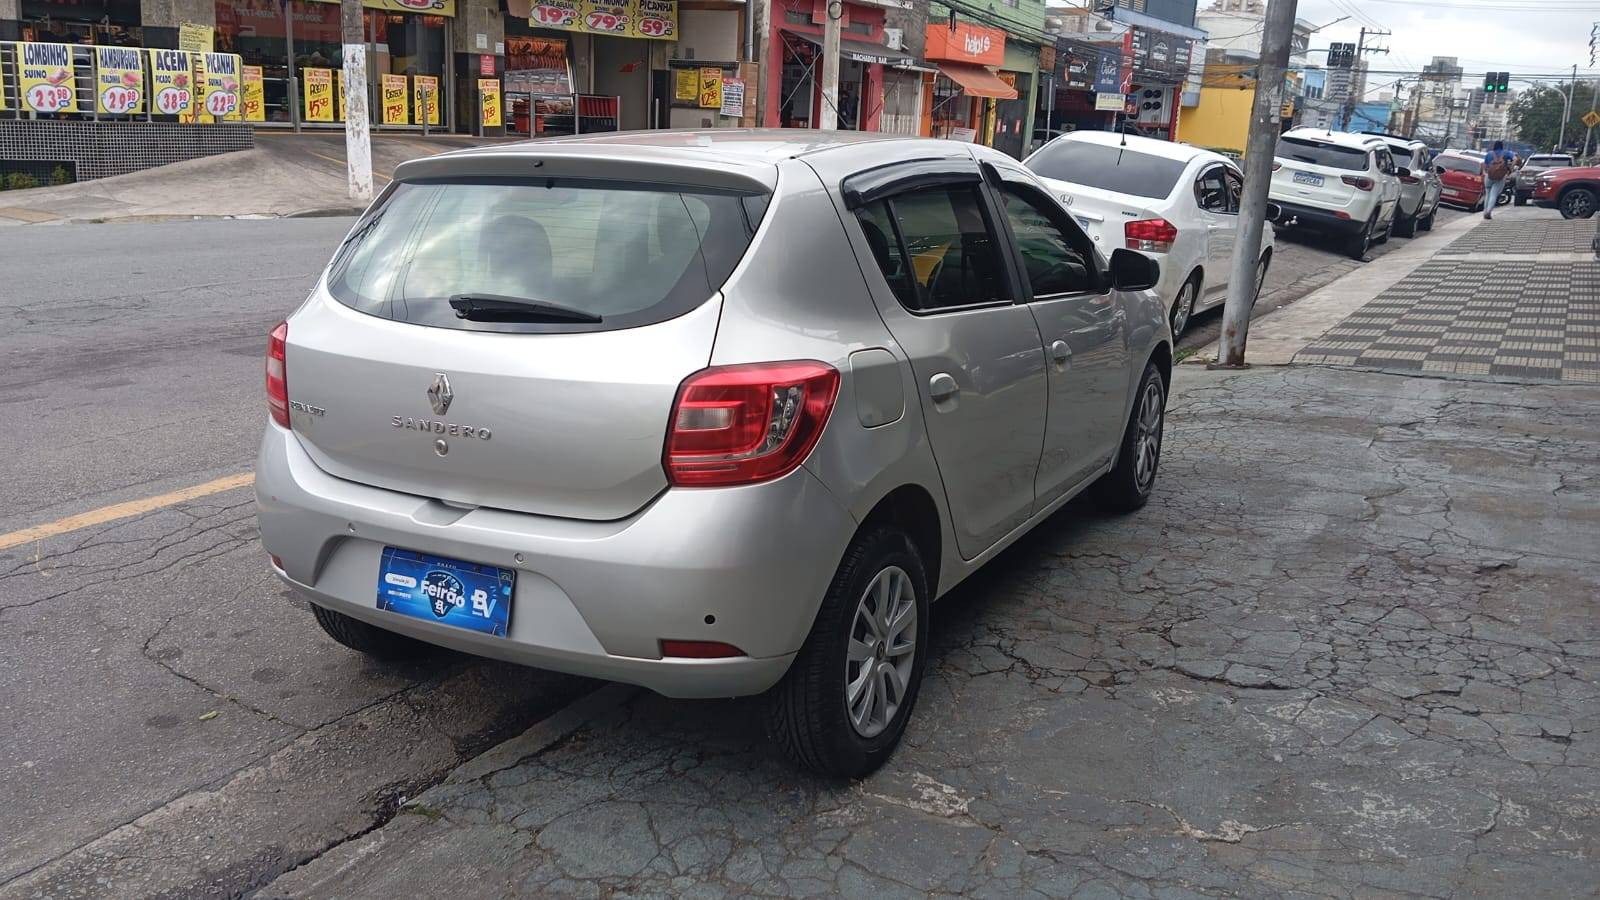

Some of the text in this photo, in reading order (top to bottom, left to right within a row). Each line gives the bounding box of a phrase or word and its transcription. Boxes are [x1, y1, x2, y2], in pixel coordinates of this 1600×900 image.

[639, 0, 673, 12] PICANHA
[23, 44, 69, 66] LOMBINHO
[964, 33, 983, 57] help!
[100, 48, 140, 70] HAMBURGUER
[156, 51, 188, 71] ACEM
[205, 53, 235, 74] PICANHA
[878, 56, 888, 65] BAR
[24, 69, 47, 78] SUINO
[391, 415, 492, 441] SANDERO
[420, 580, 465, 608] Feirão
